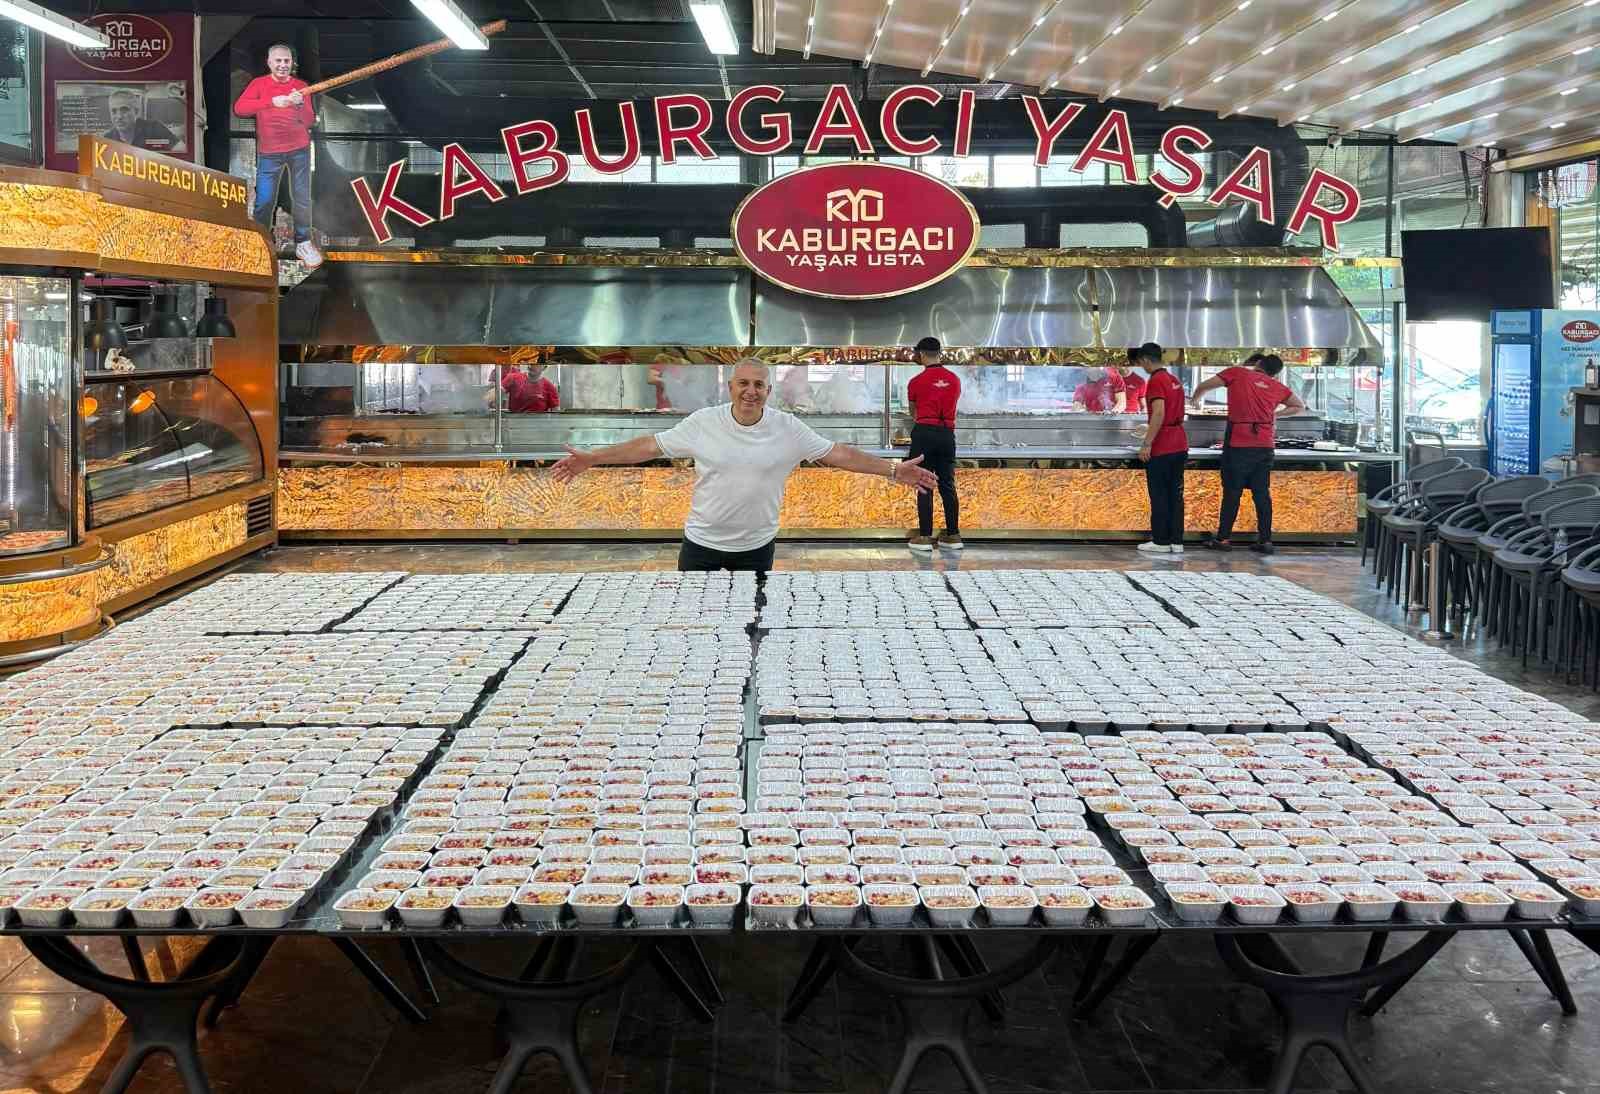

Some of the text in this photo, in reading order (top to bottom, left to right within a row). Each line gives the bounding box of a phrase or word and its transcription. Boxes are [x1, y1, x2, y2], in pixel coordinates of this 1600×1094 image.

[73, 39, 167, 51] URGACI
[87, 51, 121, 60] YAŞAR
[95, 142, 247, 209] KABURGACI YAŞAR
[350, 84, 1362, 253] KABURGACI YAŞAR
[756, 227, 954, 253] KABURGACI
[786, 253, 926, 272] YAŞAR USTA
